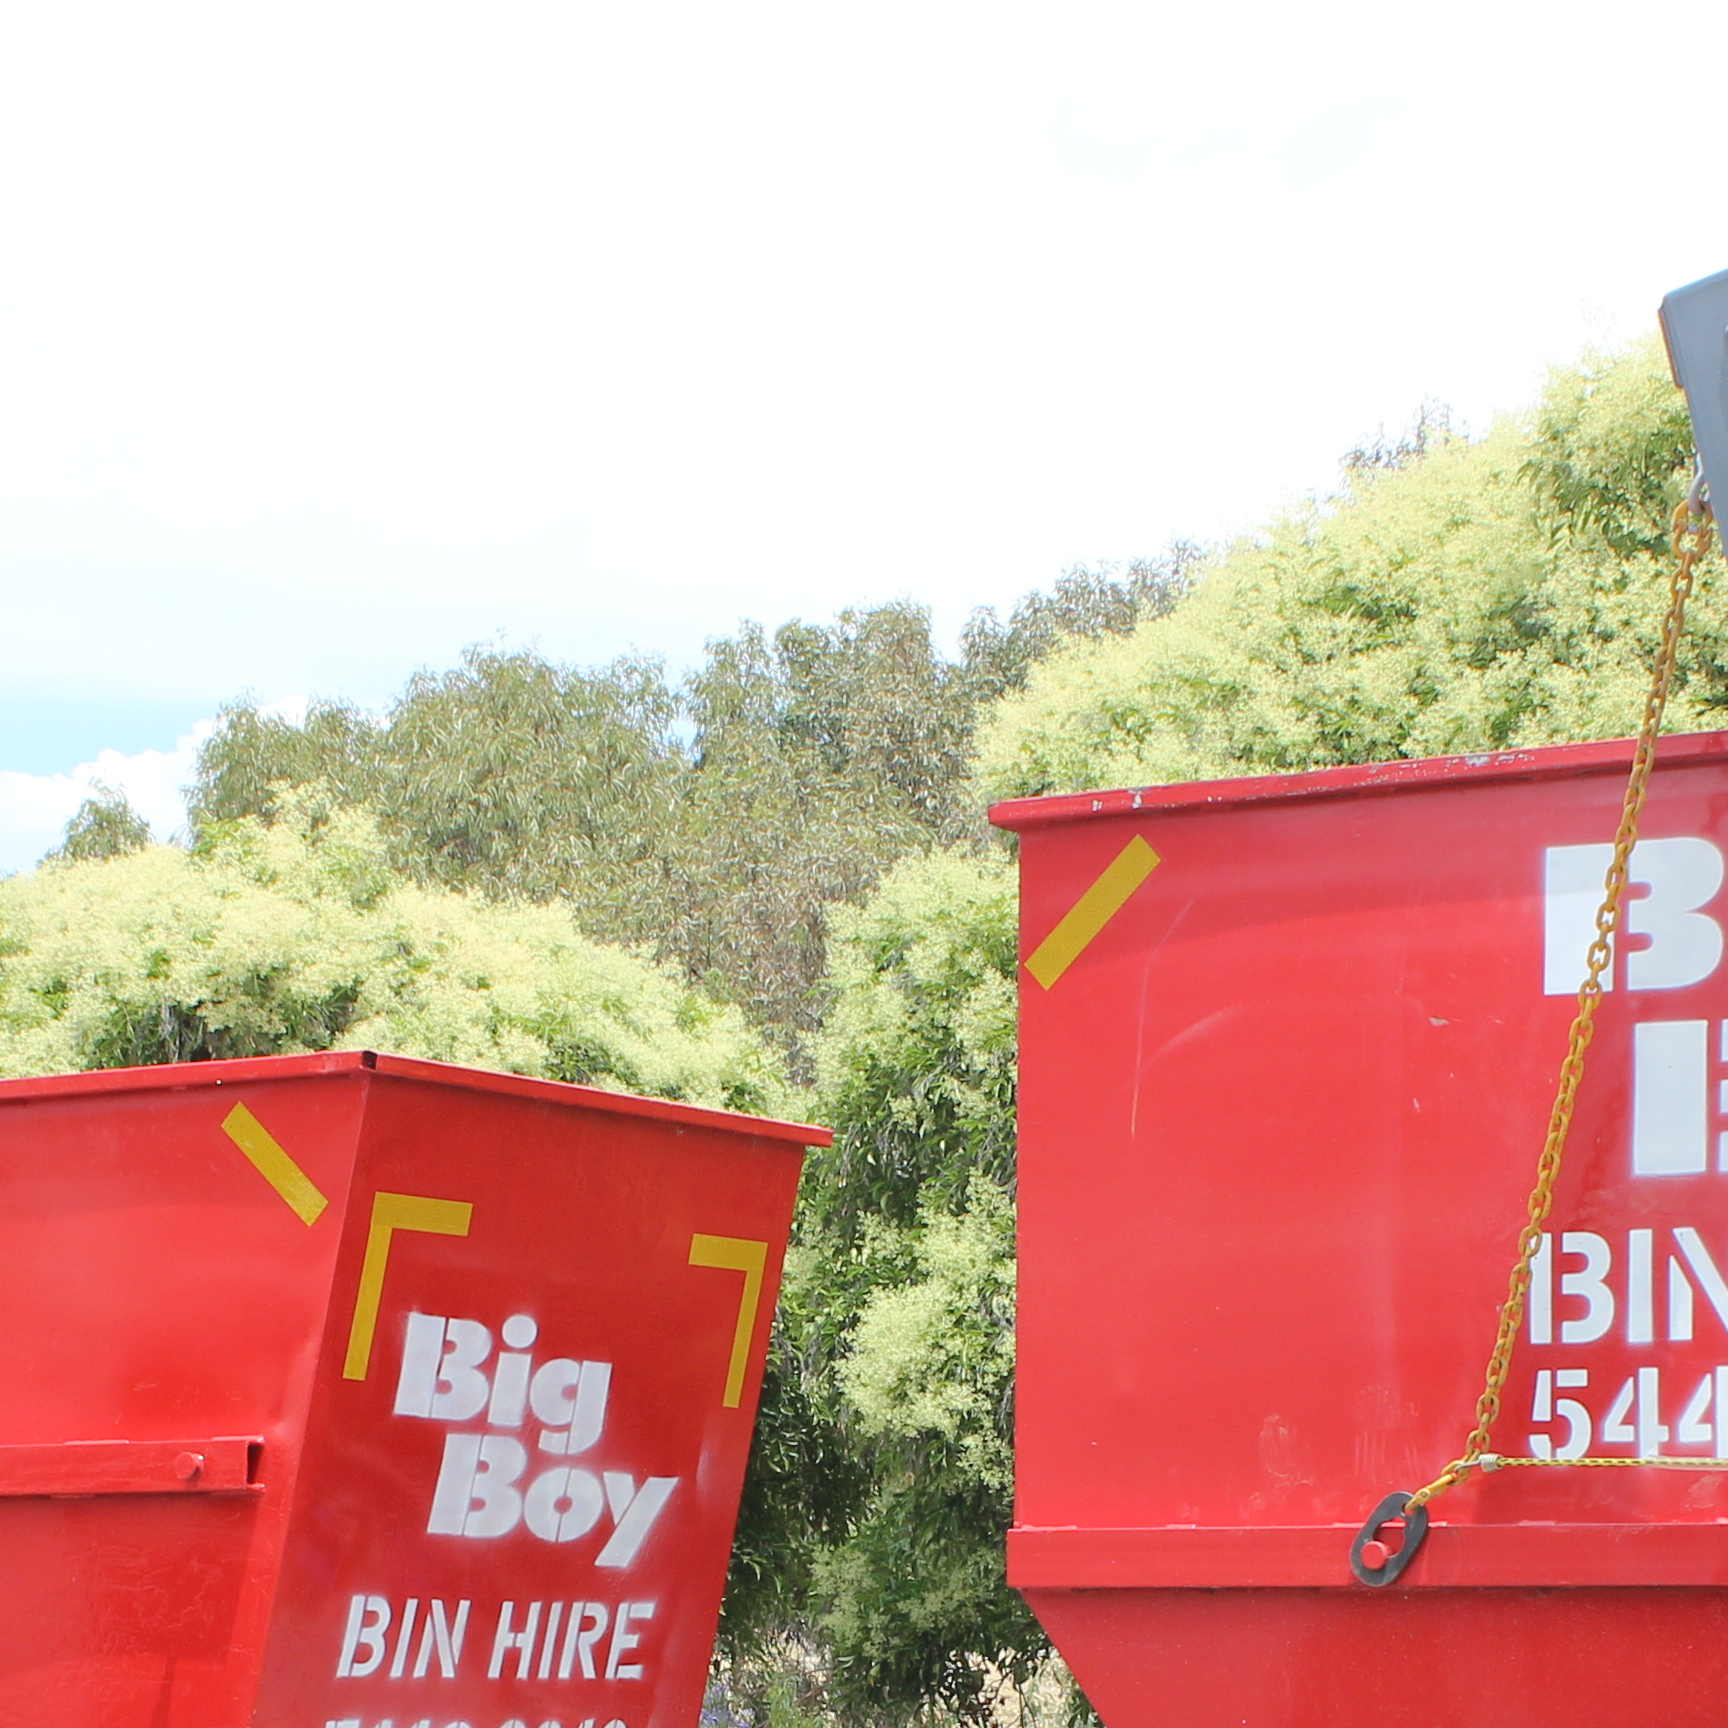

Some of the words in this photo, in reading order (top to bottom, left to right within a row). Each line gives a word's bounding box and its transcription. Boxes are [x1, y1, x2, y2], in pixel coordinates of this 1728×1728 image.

[394, 1311, 612, 1455] Big
[427, 1433, 679, 1568] Boy
[336, 1594, 471, 1679] BIN
[487, 1599, 657, 1680] HIRE
